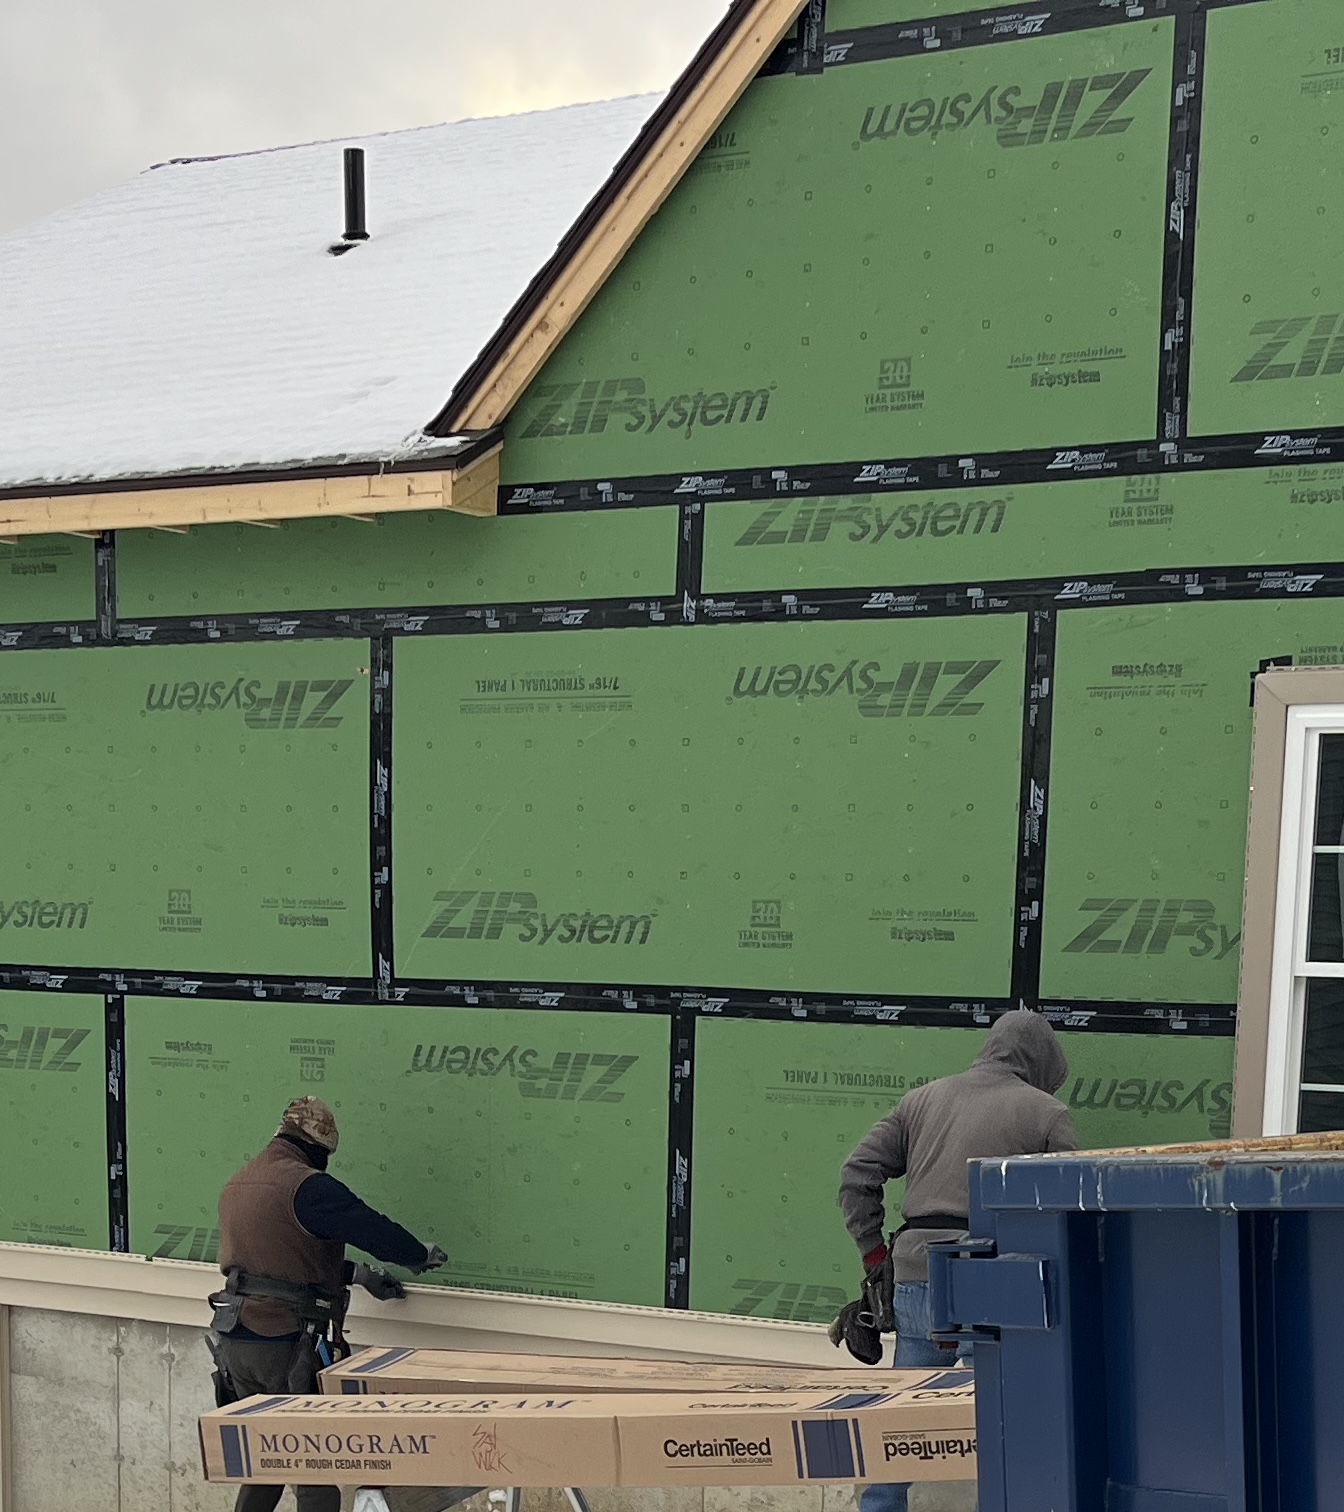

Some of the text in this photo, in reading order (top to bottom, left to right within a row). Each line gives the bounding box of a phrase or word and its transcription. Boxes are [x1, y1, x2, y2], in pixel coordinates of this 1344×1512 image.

[258, 1433, 431, 1455] MONOGRAM
[663, 1437, 772, 1459] CertainTeed
[260, 1458, 292, 1470] DOUBLE
[306, 1459, 333, 1470] ROUGH
[334, 1459, 362, 1470] CEDAR
[363, 1460, 392, 1471] FINISH
